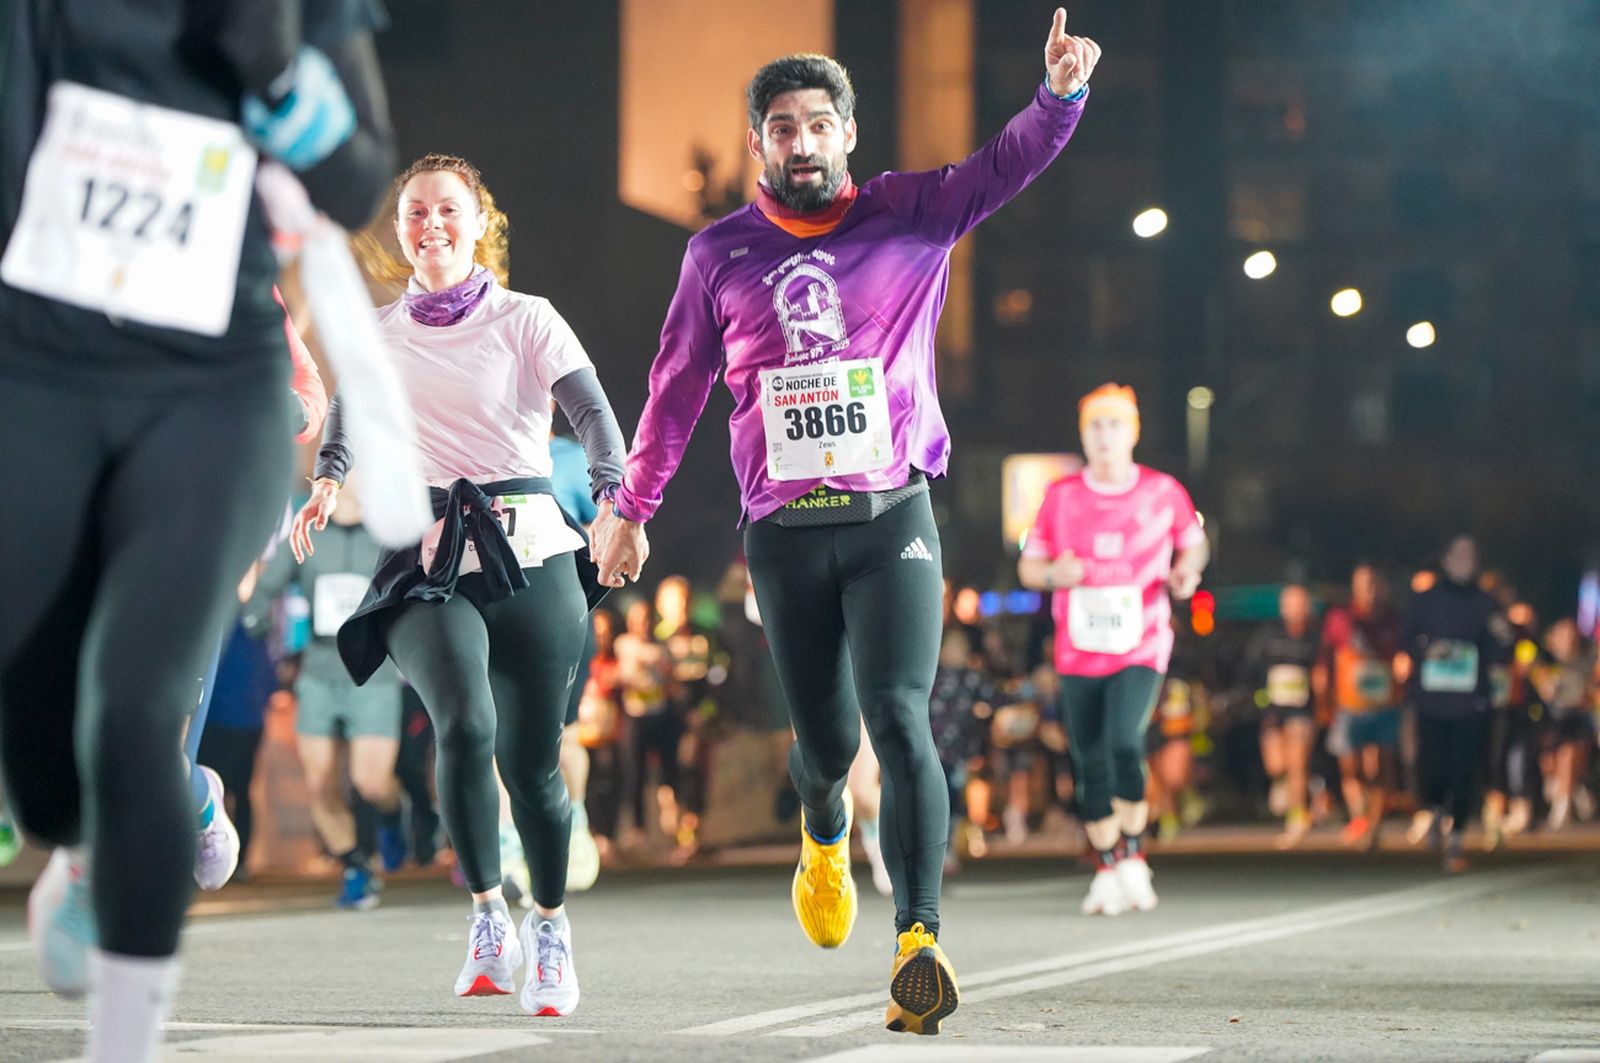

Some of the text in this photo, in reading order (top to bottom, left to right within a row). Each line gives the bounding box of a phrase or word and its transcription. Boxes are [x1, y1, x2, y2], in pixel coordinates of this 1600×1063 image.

[78, 175, 196, 248] 1224
[786, 377, 821, 391] NOCHE
[823, 376, 837, 388] DE
[774, 393, 798, 407] SAN
[800, 387, 839, 405] ANTÓN
[784, 402, 867, 441] 3866
[900, 549, 933, 562] adidas
